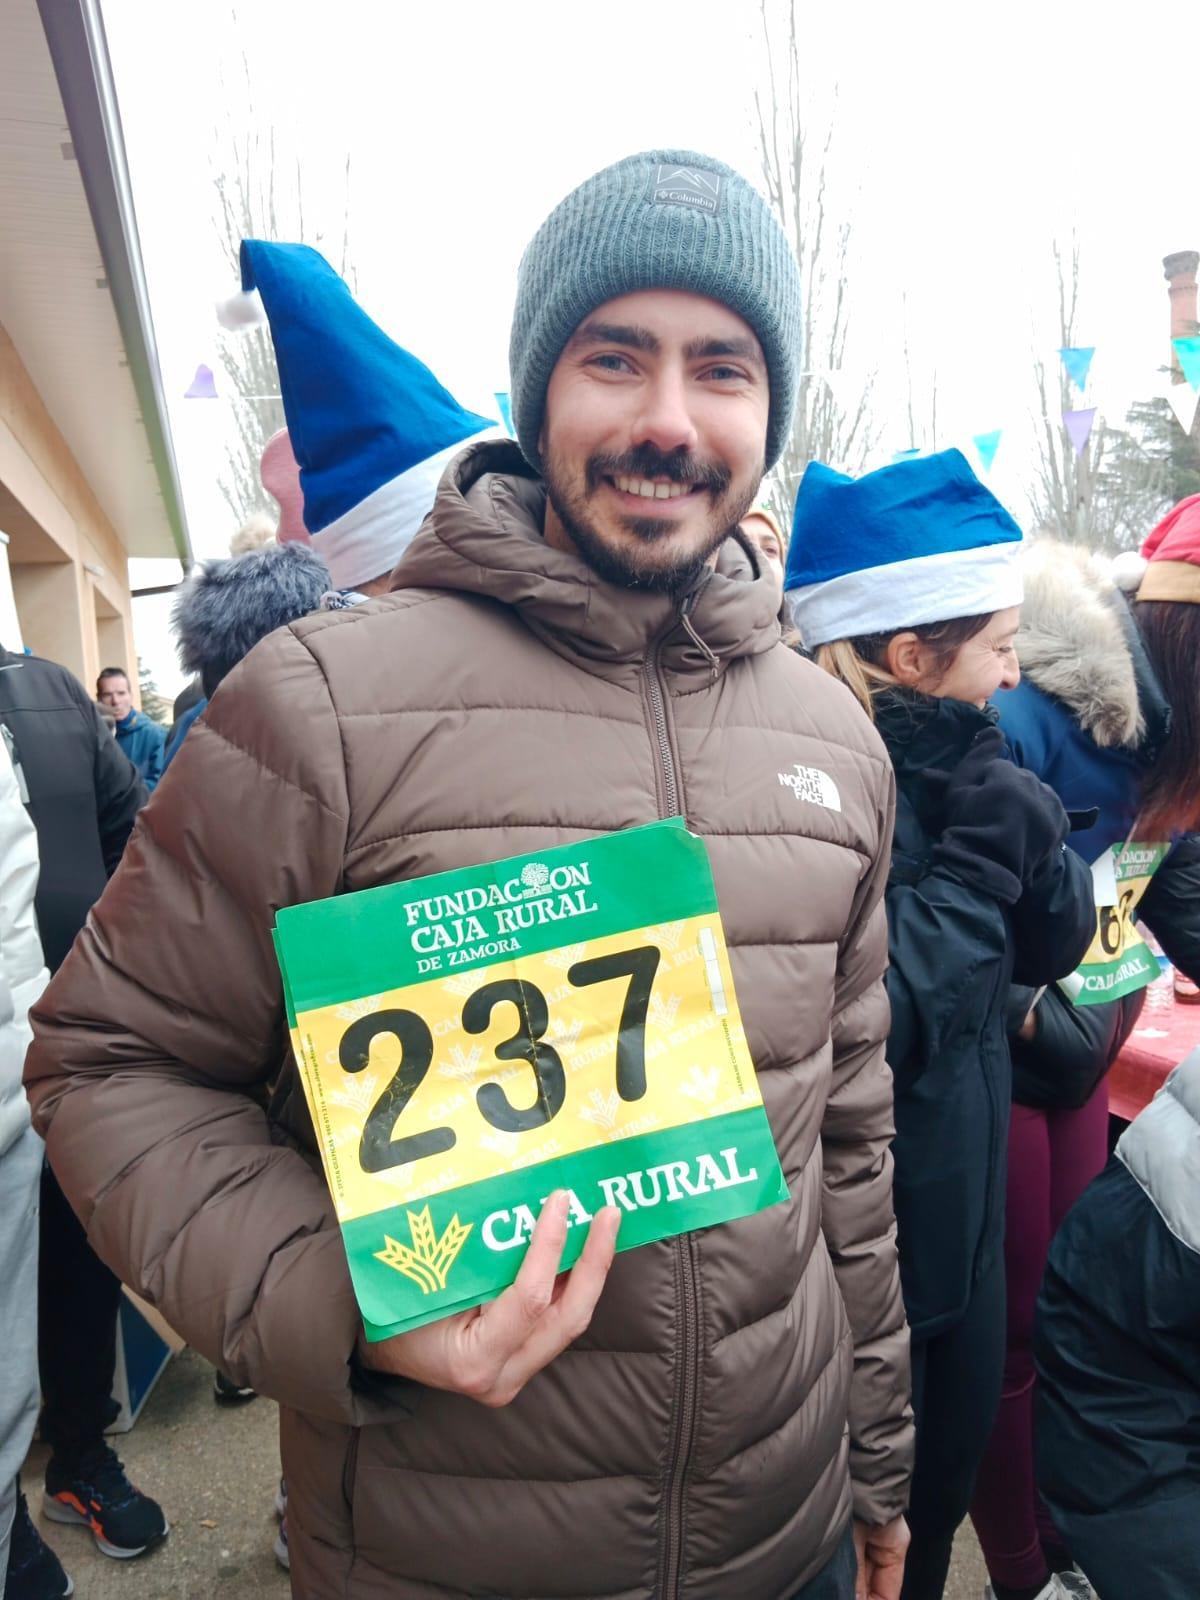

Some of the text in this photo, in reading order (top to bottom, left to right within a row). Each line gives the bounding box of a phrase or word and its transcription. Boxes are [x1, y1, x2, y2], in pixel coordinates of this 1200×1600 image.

[669, 192, 713, 208] Columbia
[777, 773, 822, 794] NORTH
[793, 764, 820, 780] THE
[794, 787, 824, 806] FACE
[411, 889, 599, 954] CAJA RURAL
[416, 936, 522, 974] DE ZAMORA
[339, 945, 661, 1174] 237
[481, 1147, 759, 1252] CAA RURAL
